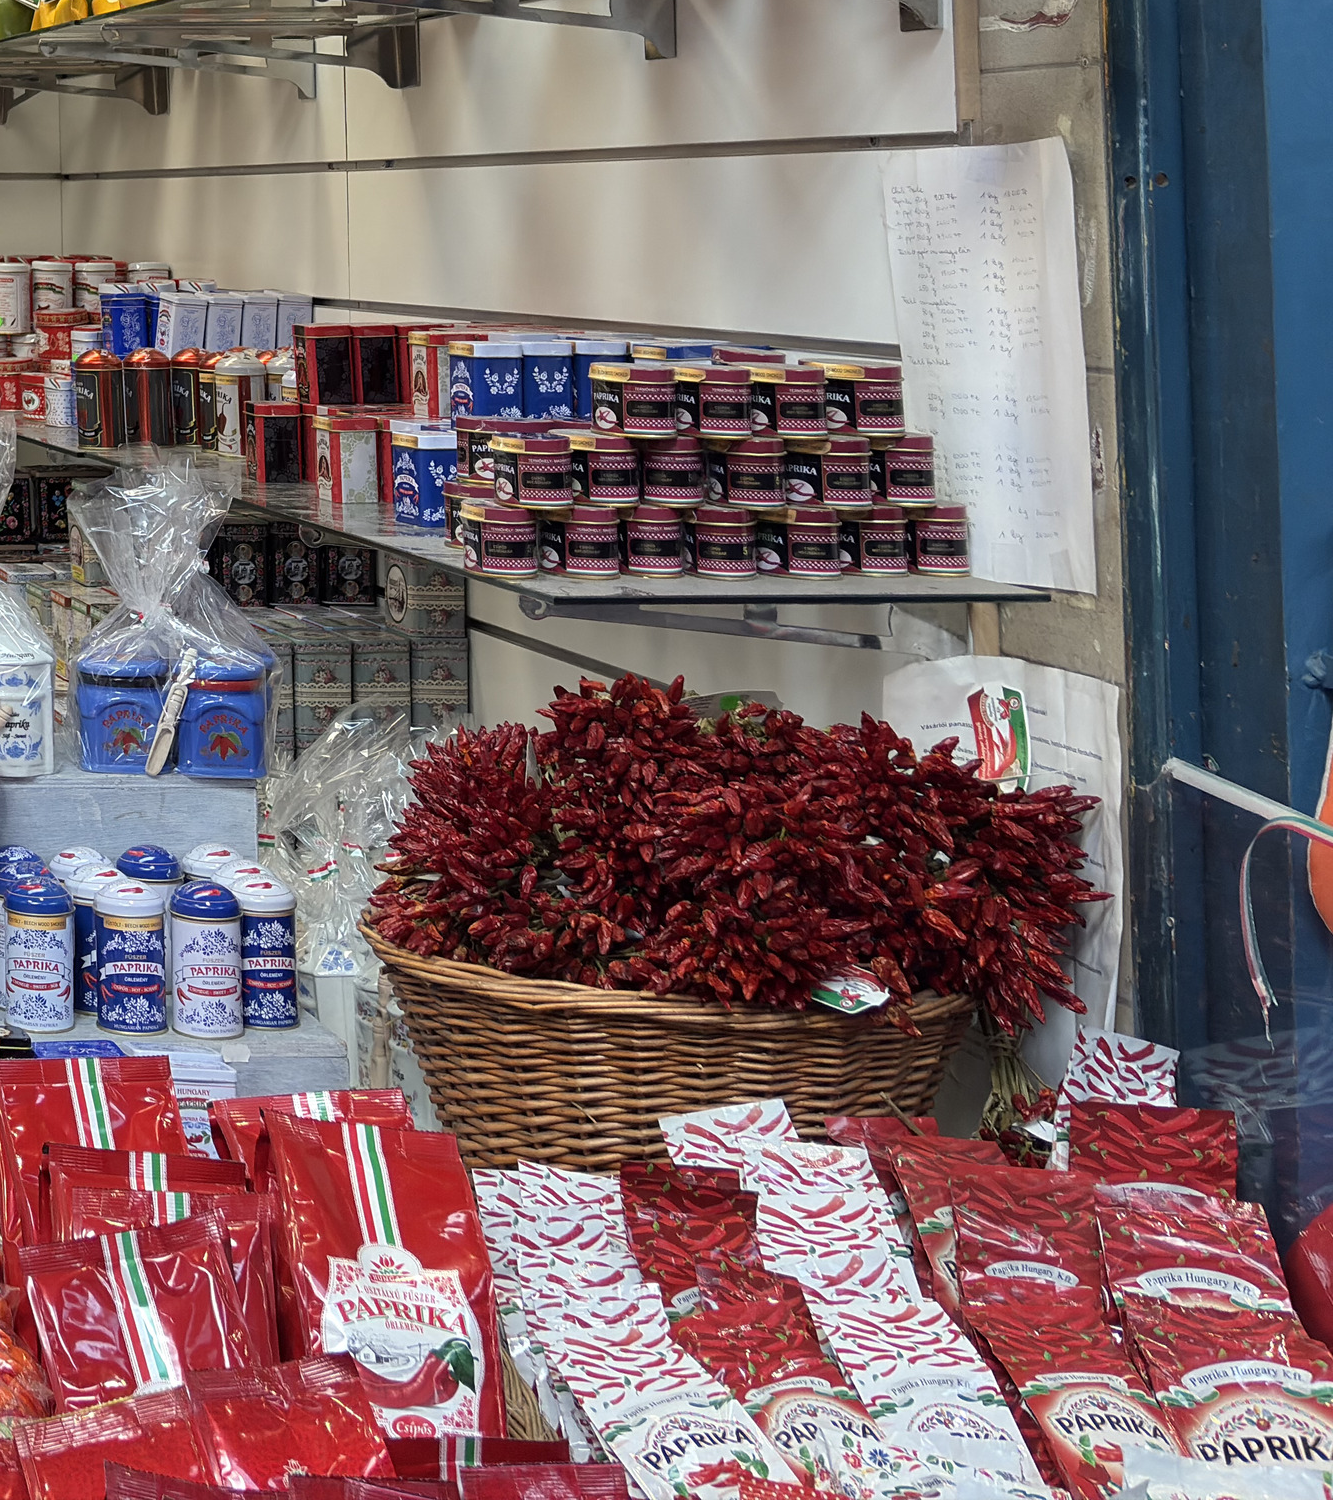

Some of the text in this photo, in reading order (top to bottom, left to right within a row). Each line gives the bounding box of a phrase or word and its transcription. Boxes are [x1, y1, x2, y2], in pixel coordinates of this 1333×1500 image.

[13, 959, 60, 972] PAPRIKA
[112, 962, 159, 974] PAPRIKA
[248, 958, 294, 969] PAPRIKA
[190, 966, 237, 977] PAPRIKA
[177, 1088, 210, 1096] HUNGARY
[1021, 1264, 1054, 1278] Hungary
[1144, 1272, 1183, 1288] Paprika
[1185, 1272, 1230, 1289] Hungary
[336, 1297, 467, 1334] PAPRIKA
[1188, 1365, 1275, 1387] Paprika Hungary
[919, 1378, 954, 1391] Hungary
[393, 1420, 433, 1439] Csípős
[1055, 1414, 1169, 1443] PAPRIKA
[643, 1427, 753, 1471] PAPRIKA
